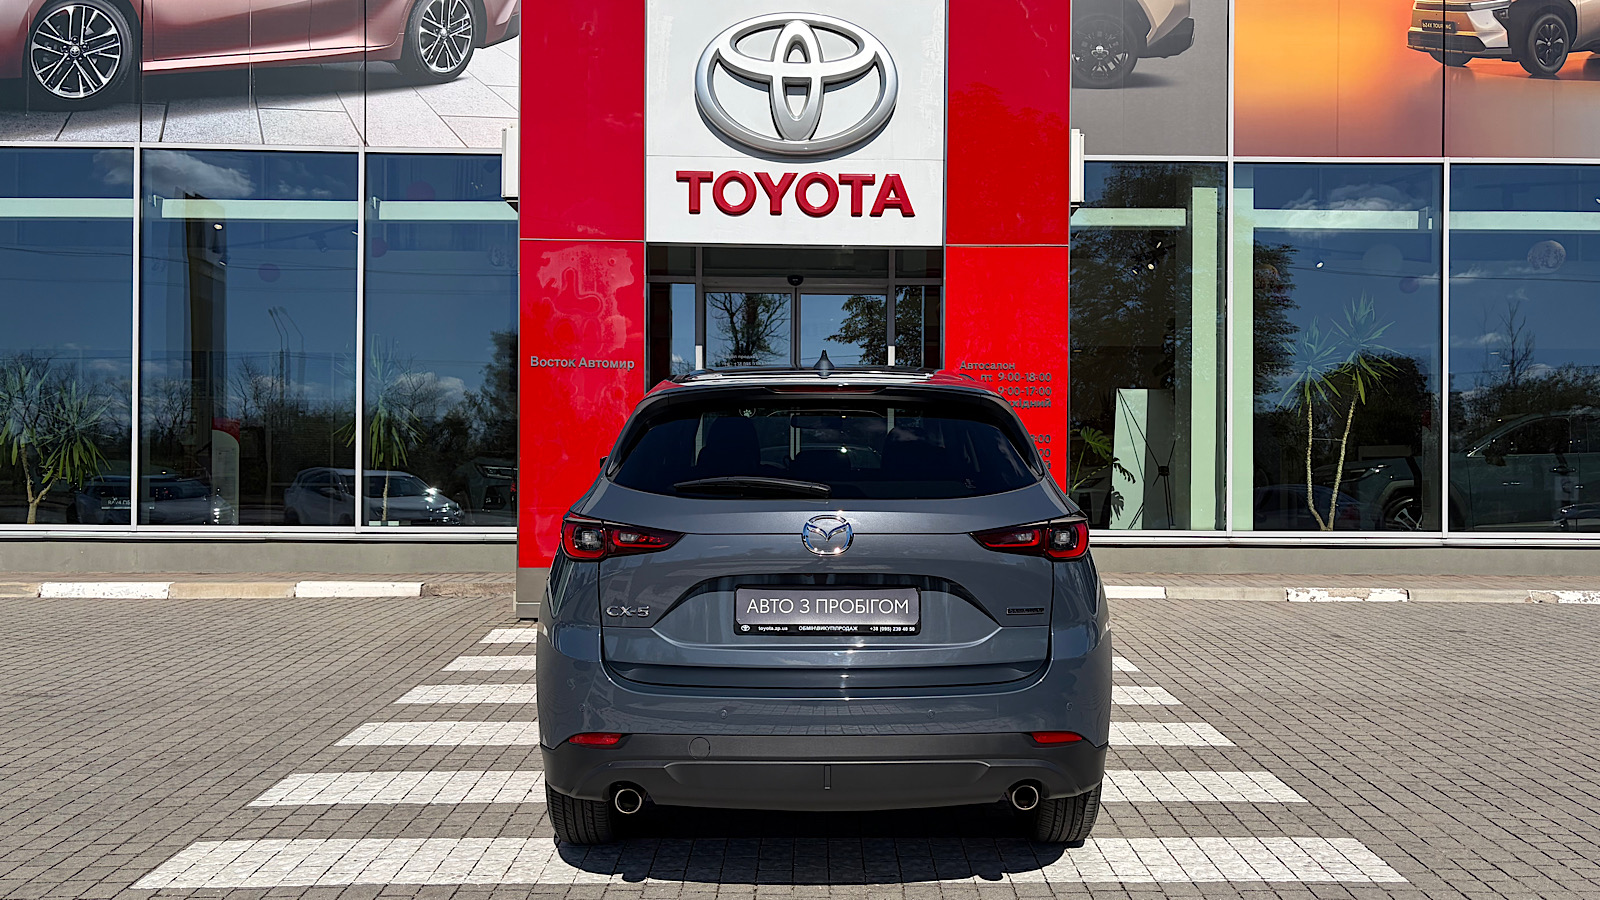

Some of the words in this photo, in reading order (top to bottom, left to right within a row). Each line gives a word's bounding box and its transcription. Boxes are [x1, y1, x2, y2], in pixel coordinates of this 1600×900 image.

[676, 170, 916, 218] TOYOTA
[530, 355, 576, 368] Восток
[578, 357, 635, 371] Автомир
[959, 361, 1016, 370] Автосалон
[997, 372, 1052, 382] 9:00-18:00
[997, 386, 1052, 396] 9:00-17:00
[606, 605, 650, 617] CX-5
[746, 598, 794, 614] АВТО
[816, 598, 909, 614] ПРОБІГОМ
